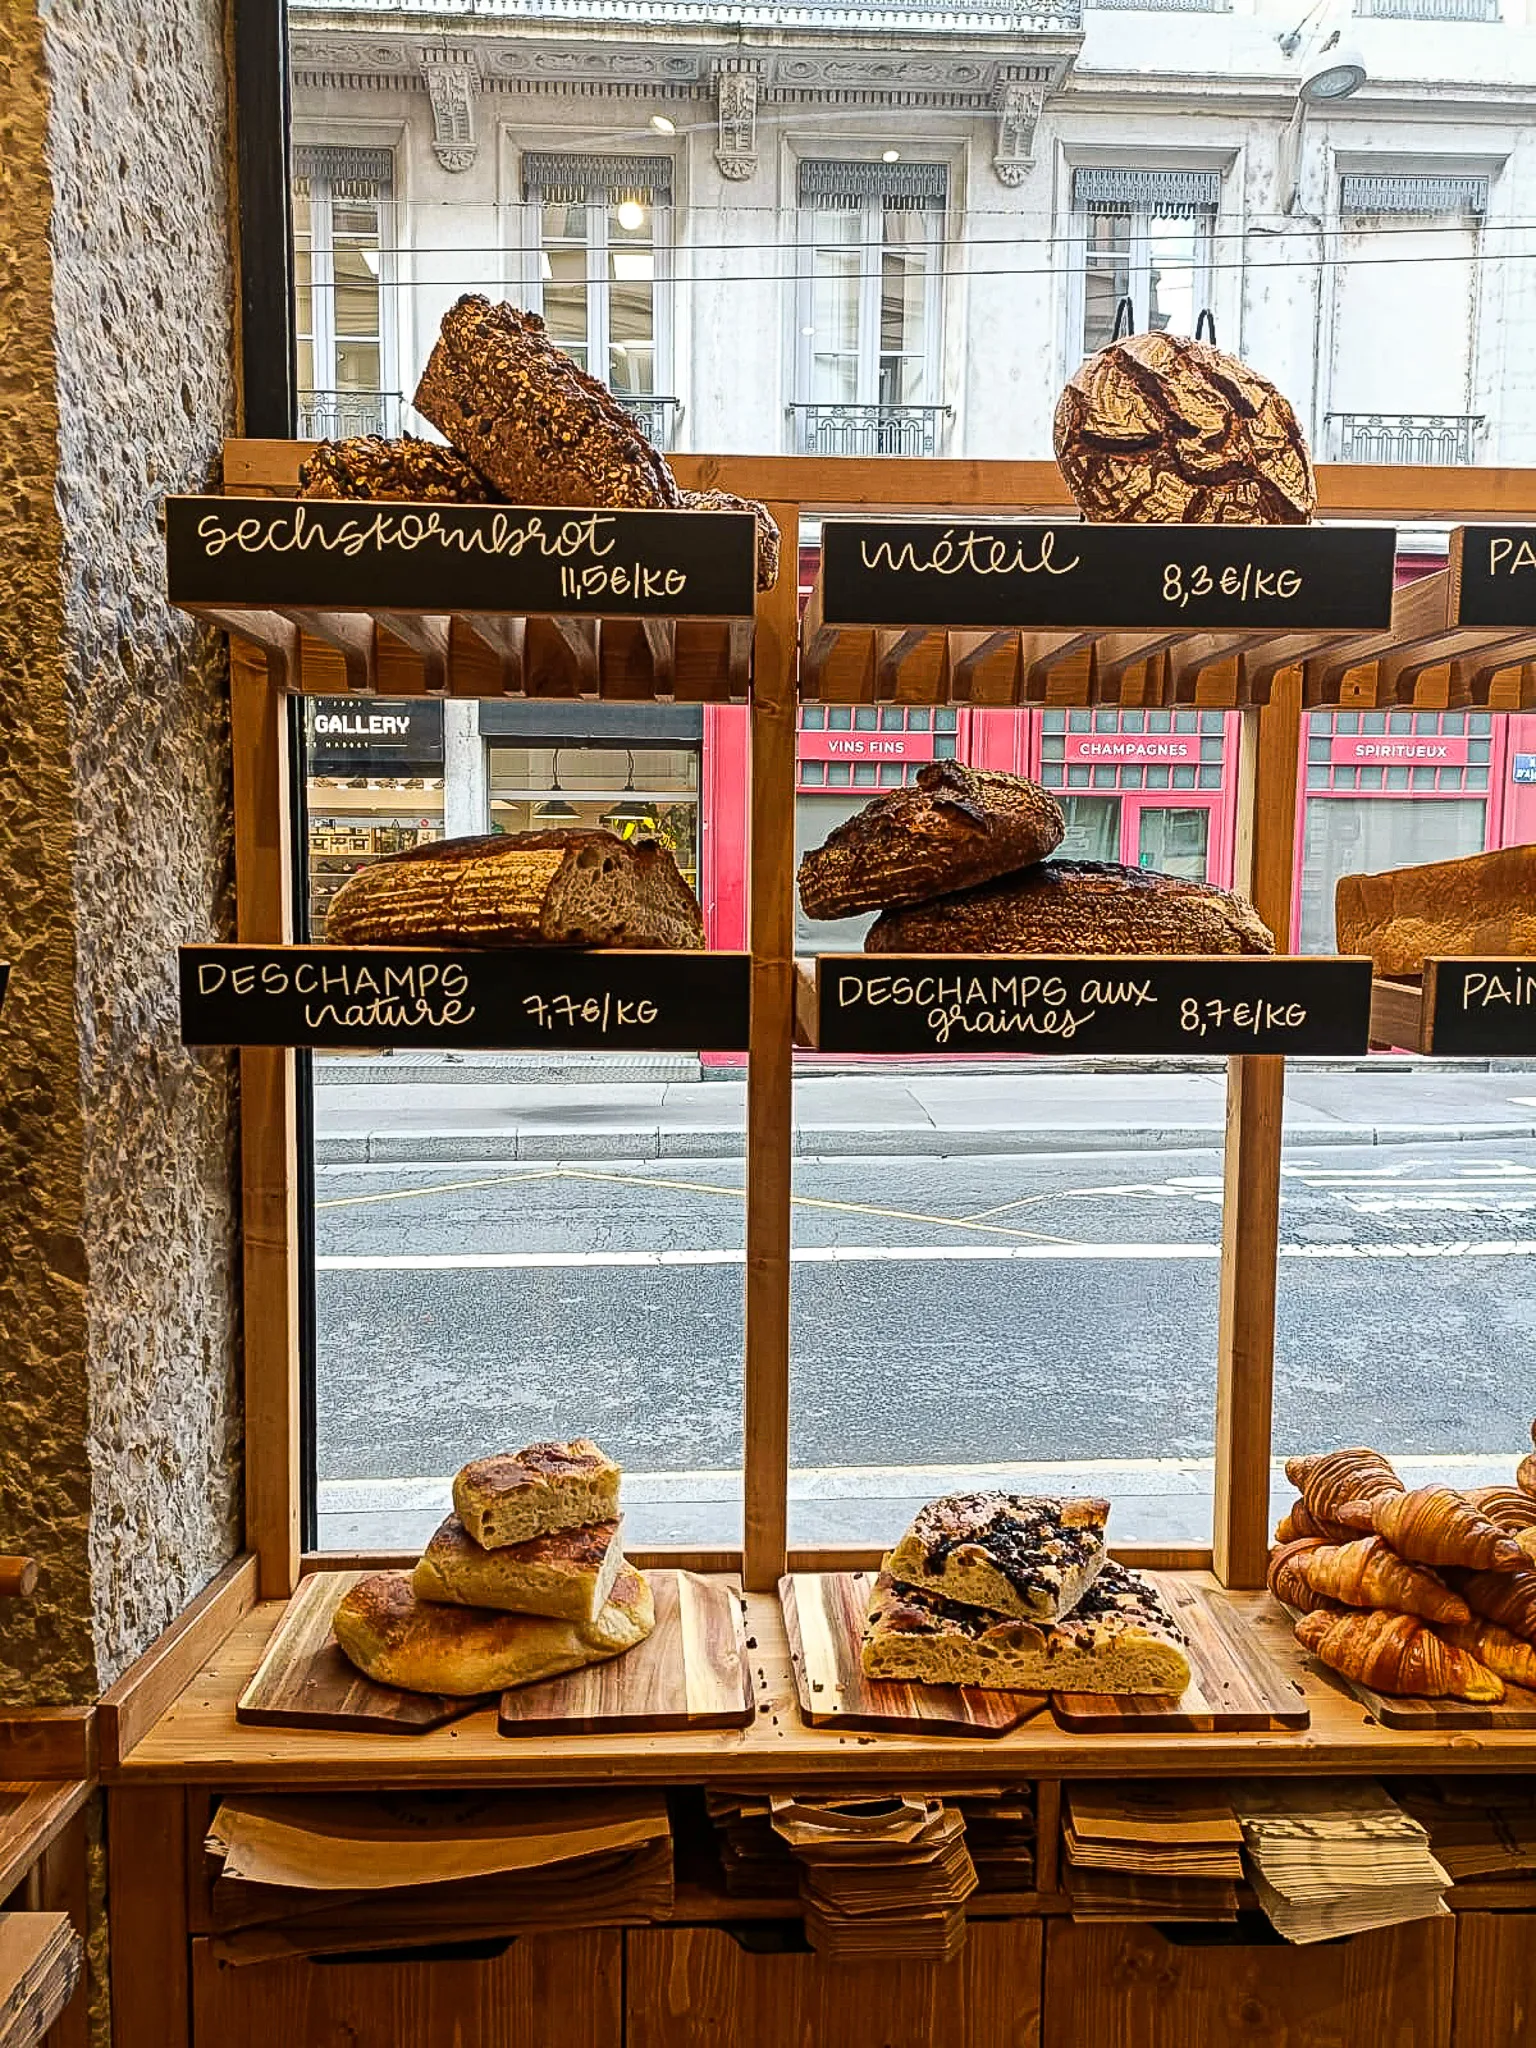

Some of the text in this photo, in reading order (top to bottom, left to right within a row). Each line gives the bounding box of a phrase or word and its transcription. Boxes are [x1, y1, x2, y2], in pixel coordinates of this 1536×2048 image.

[197, 506, 616, 557] sechskornbrot
[861, 530, 1080, 575] méteil
[314, 714, 411, 735] GALLERY
[828, 740, 905, 754] VINS FINS
[1079, 743, 1188, 756] CHAMPAGNES
[1355, 744, 1447, 757] SPIRITUEUX
[198, 963, 469, 999] DESCHAMPS
[839, 976, 1158, 1007] DESCHAMPS aux
[305, 996, 476, 1028] nature
[927, 1006, 1097, 1043] graines
